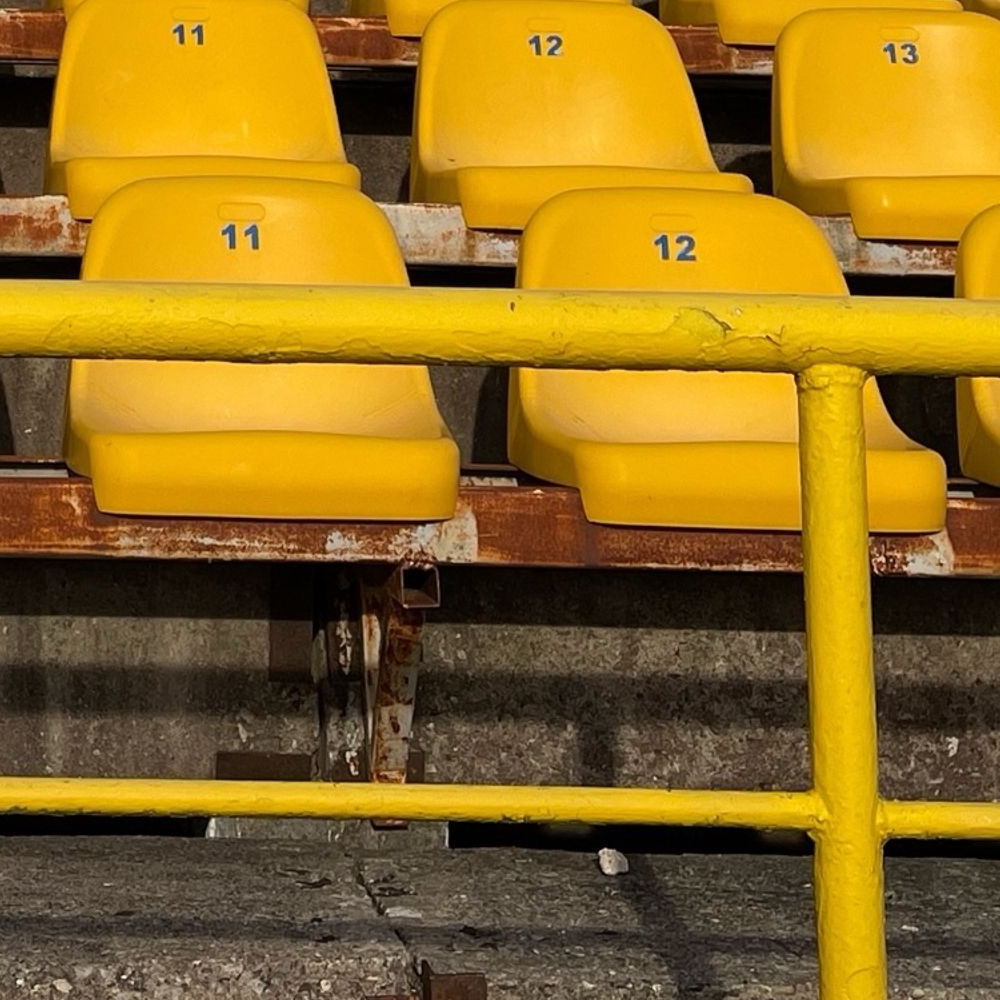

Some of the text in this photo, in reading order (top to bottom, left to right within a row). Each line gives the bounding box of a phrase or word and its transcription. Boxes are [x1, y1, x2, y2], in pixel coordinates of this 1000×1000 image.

[173, 24, 204, 45] 11
[528, 35, 563, 56] 12
[883, 43, 919, 64] 13
[221, 223, 259, 250] 11
[654, 234, 696, 261] 12
